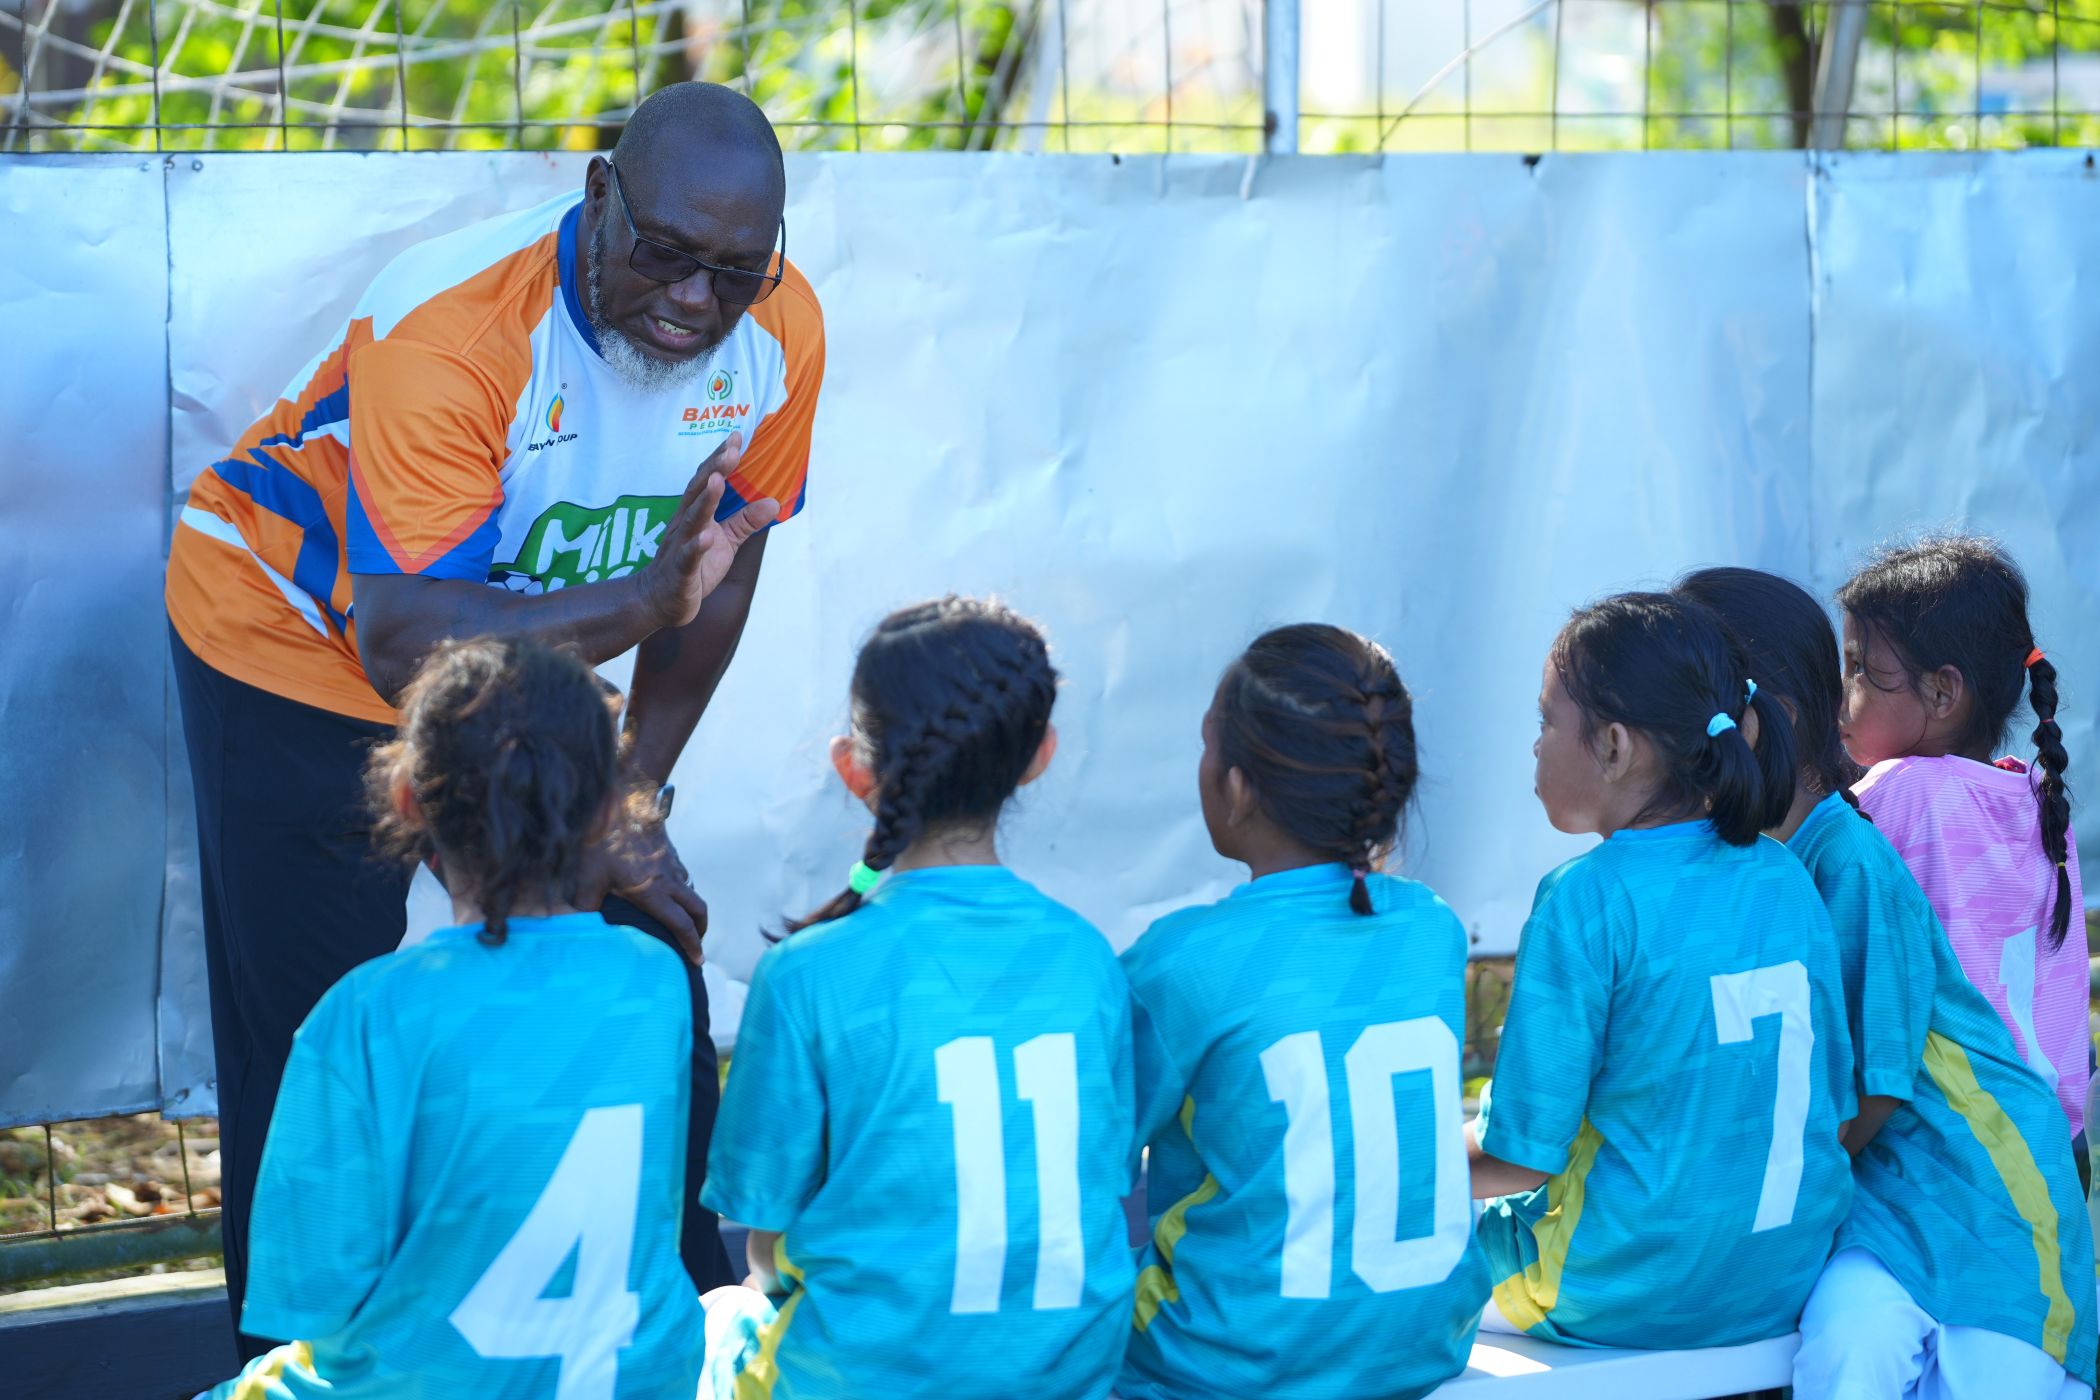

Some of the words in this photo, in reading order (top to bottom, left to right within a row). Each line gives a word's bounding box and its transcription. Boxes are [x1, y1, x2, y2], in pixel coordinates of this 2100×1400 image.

[527, 438, 556, 452] BAYN
[556, 433, 578, 444] OUP
[682, 403, 750, 422] BAYAN
[689, 420, 734, 430] PEDUL
[536, 508, 667, 575] Milk
[934, 1033, 1085, 1315] 11
[1258, 1015, 1472, 1299] 10
[1709, 959, 1815, 1234] 7
[448, 1103, 643, 1400] 4
